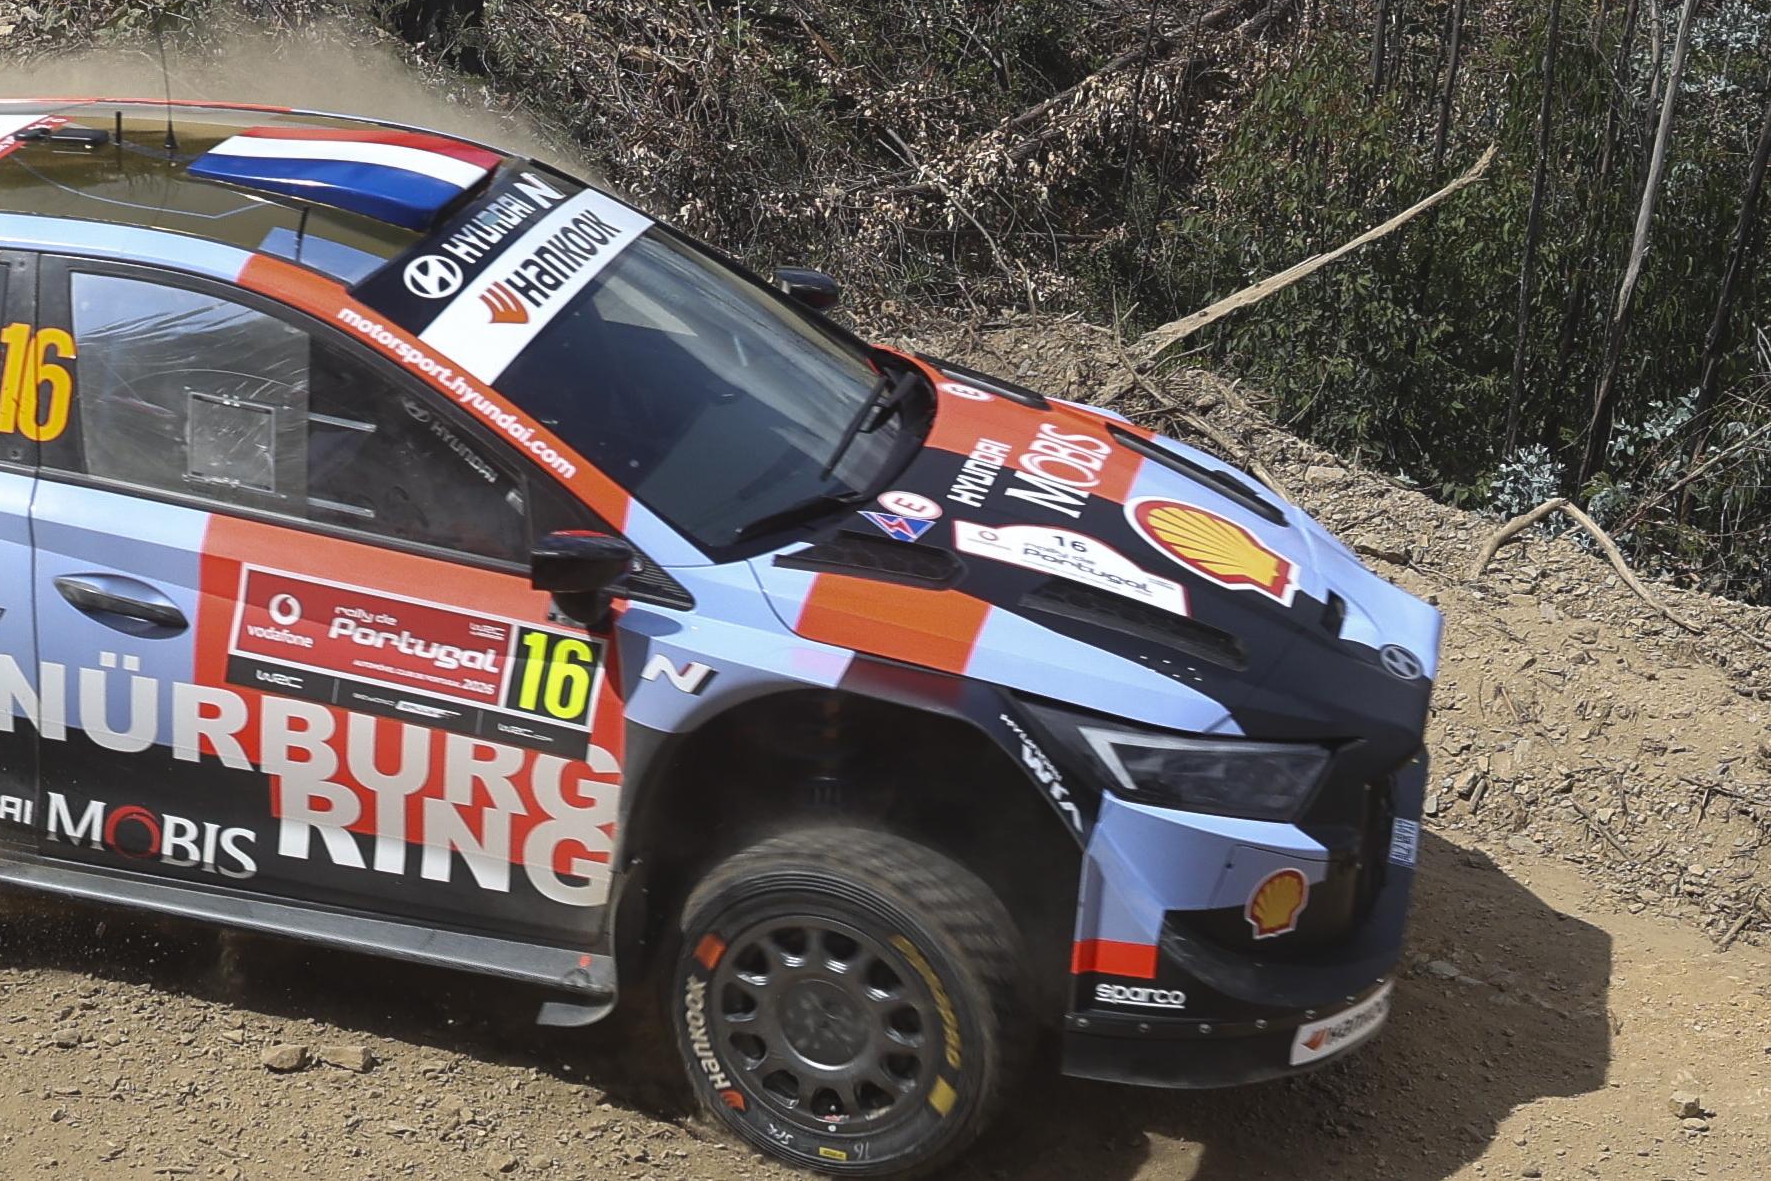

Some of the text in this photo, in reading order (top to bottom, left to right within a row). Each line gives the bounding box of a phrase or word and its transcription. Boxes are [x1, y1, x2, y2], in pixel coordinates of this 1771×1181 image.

[442, 192, 536, 265] HYUNDAI
[337, 308, 577, 479] motorsport.hyundai.com
[946, 437, 1013, 508] HYUNDAI
[1004, 422, 1113, 520] MOBIS
[1052, 535, 1088, 553] 16
[246, 623, 314, 648] vodafone
[328, 616, 500, 674] Portugal
[334, 606, 398, 626] rally de
[518, 631, 593, 719] 16
[45, 790, 259, 880] MOBIS
[278, 772, 618, 907] RING
[1094, 983, 1187, 1008] sparco
